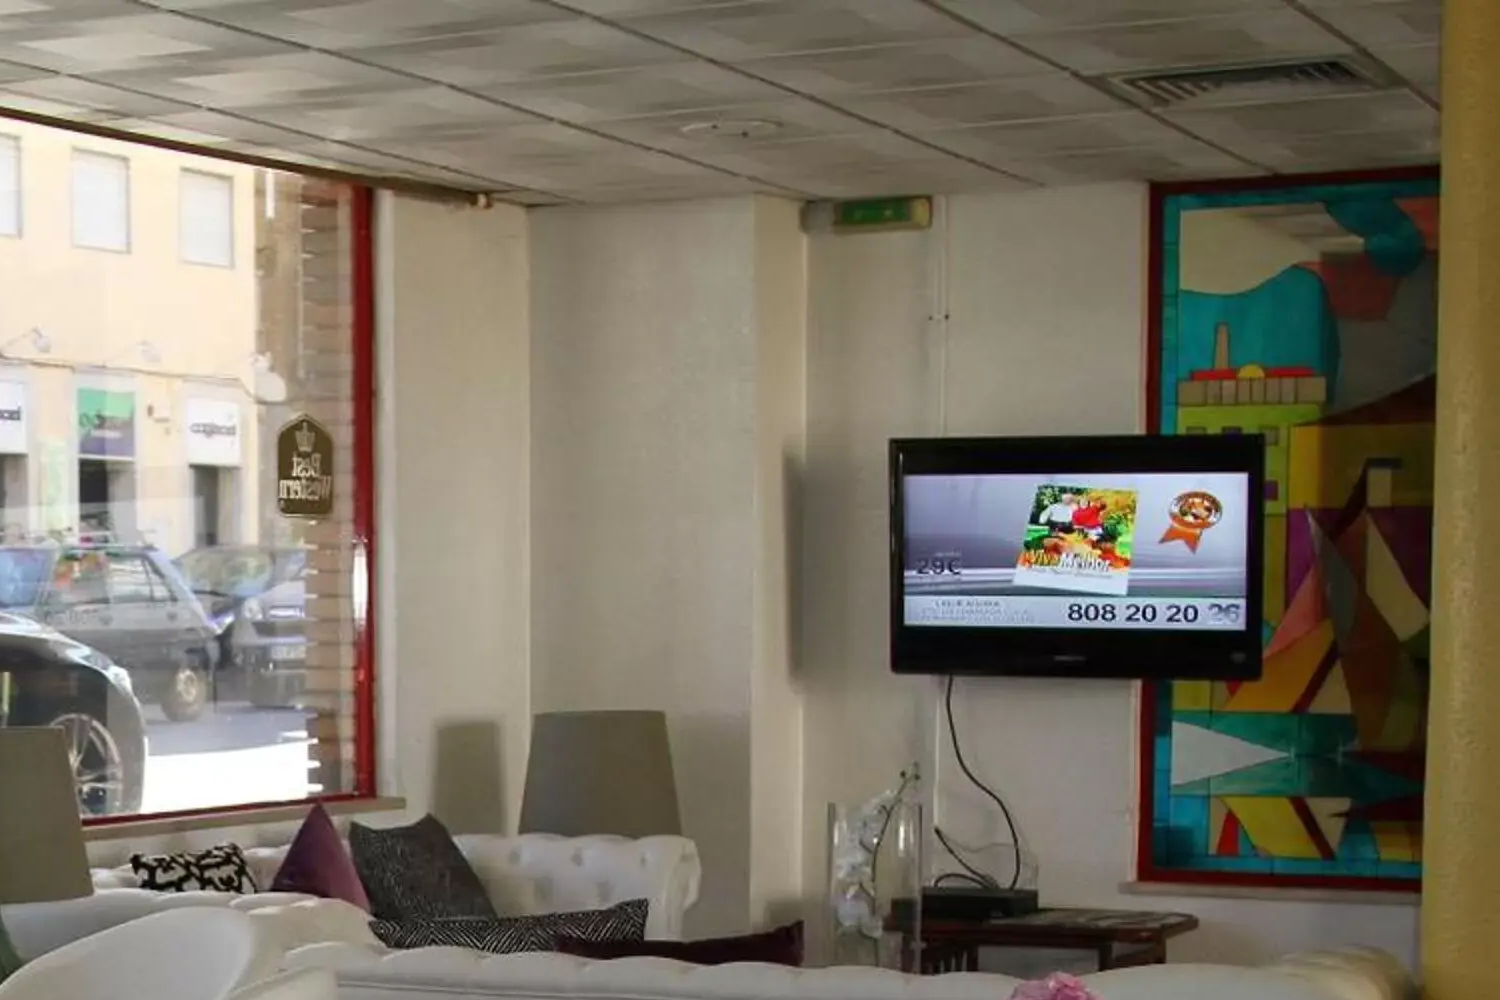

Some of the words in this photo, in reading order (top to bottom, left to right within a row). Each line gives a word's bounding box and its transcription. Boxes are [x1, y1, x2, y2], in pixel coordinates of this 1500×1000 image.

[1067, 603, 1117, 622] 808
[1125, 604, 1157, 623] 20
[1166, 604, 1199, 623] 20
